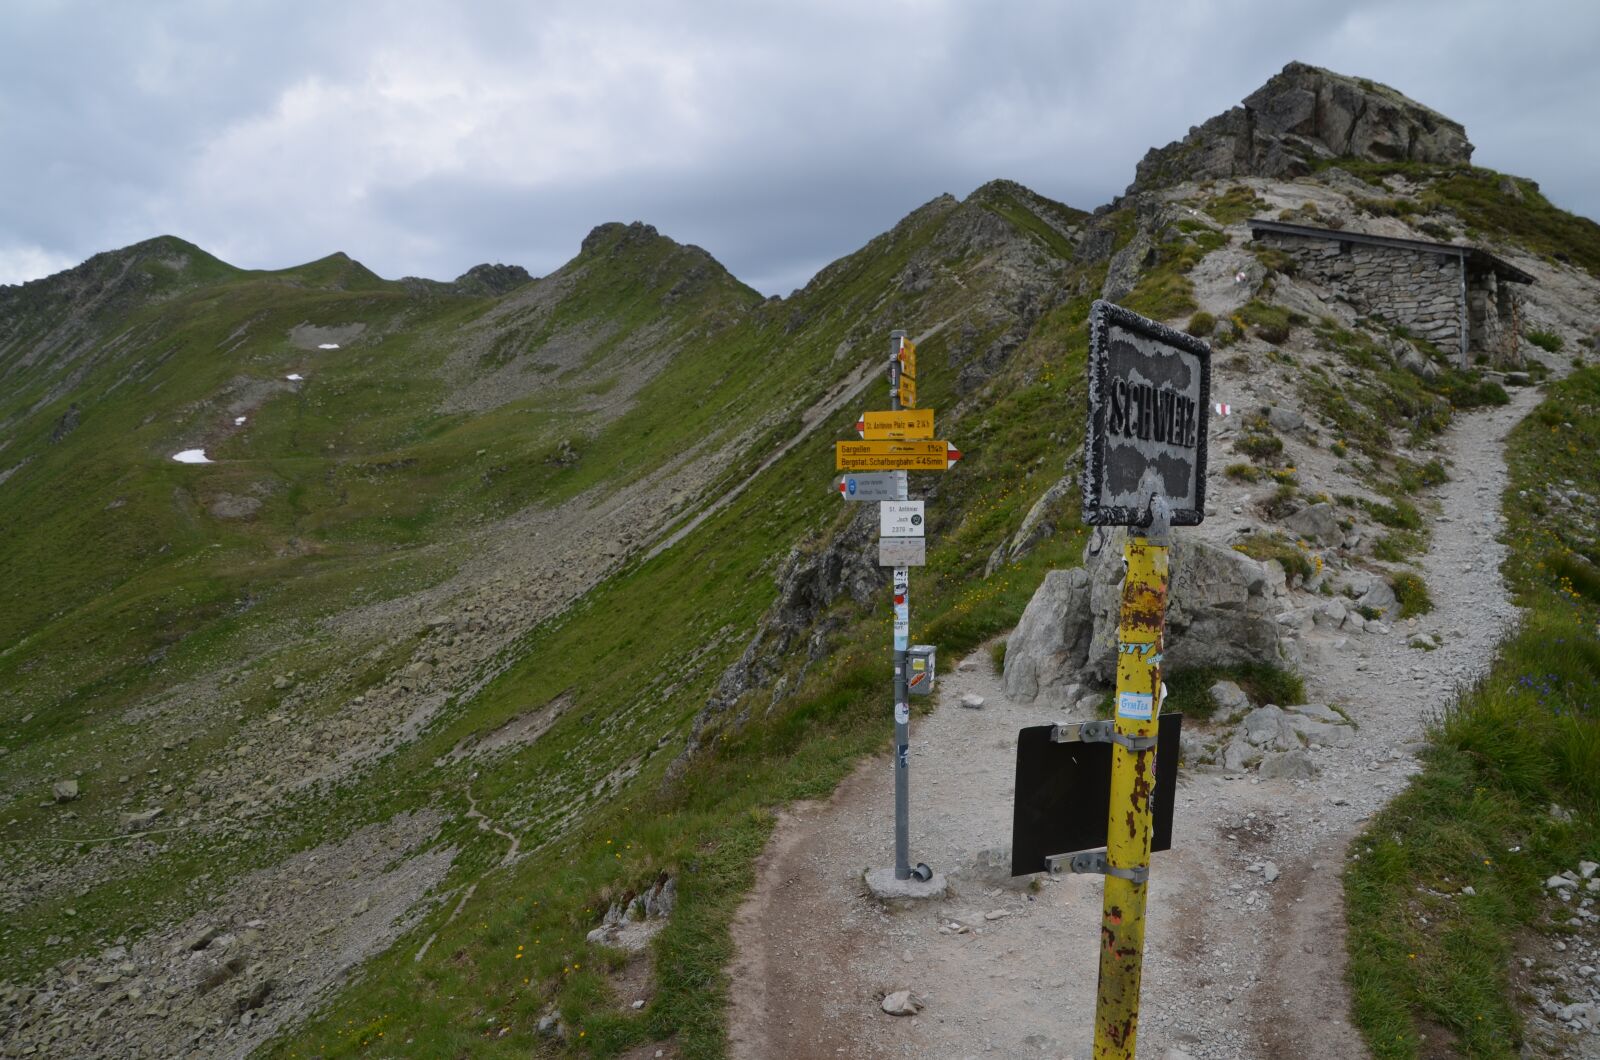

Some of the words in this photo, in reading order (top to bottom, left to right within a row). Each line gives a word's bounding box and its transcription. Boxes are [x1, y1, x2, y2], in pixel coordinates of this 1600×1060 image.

[1109, 378, 1196, 448] SCHWEIZ
[841, 445, 871, 456] Gargellen
[870, 457, 914, 467] Schafbergbahn
